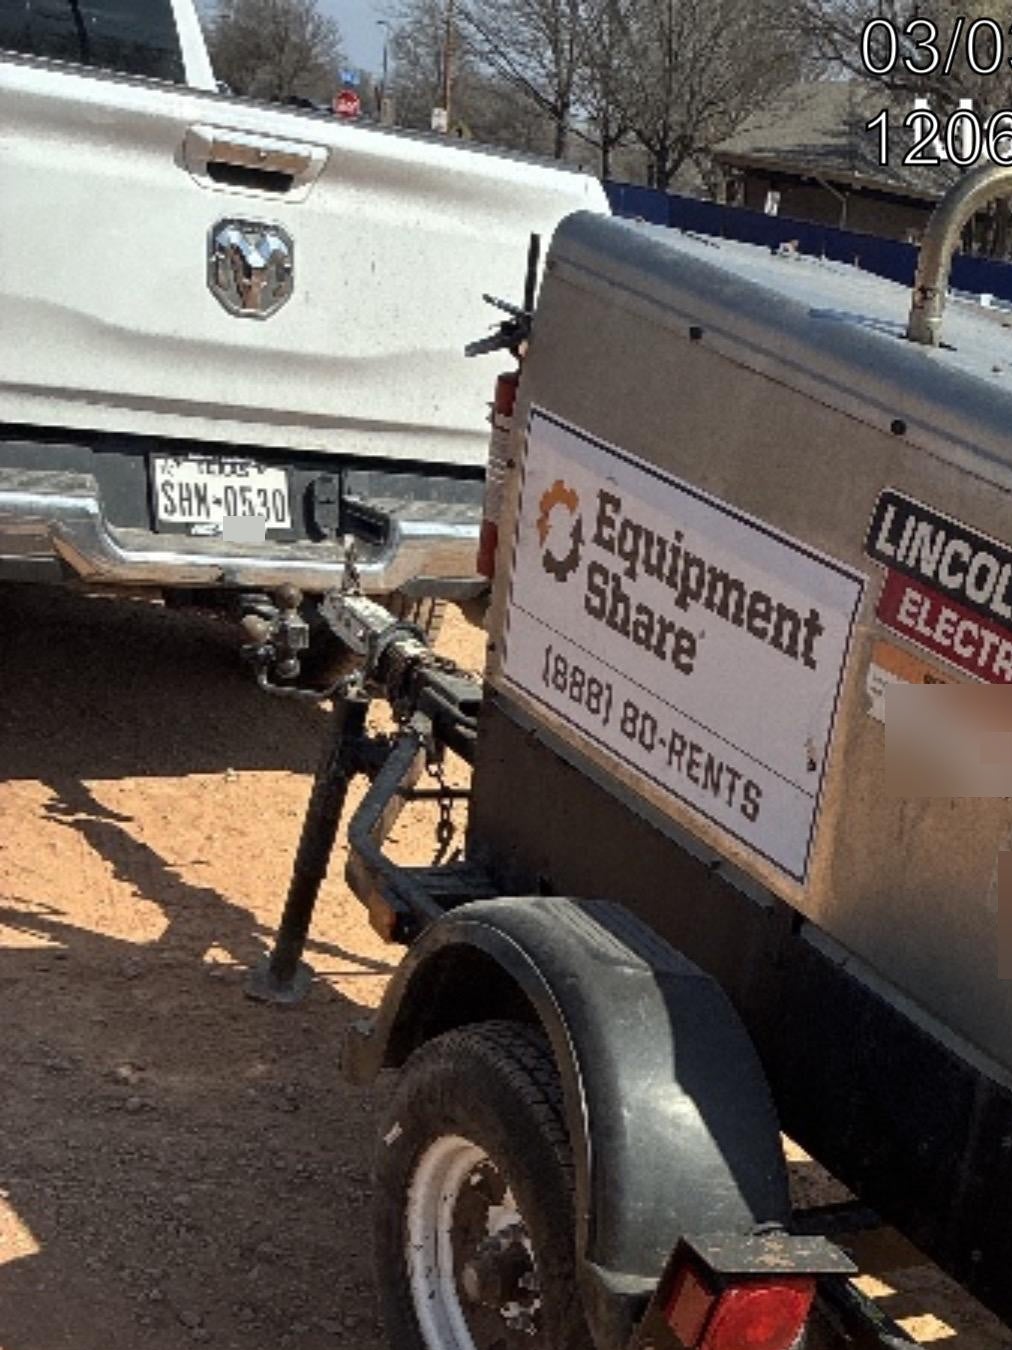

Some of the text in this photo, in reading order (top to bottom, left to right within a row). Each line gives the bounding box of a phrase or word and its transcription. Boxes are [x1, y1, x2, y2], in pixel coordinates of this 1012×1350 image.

[584, 560, 698, 675] Share
[592, 488, 824, 670] Equipment
[542, 644, 763, 822] (888) 80-RENTS
